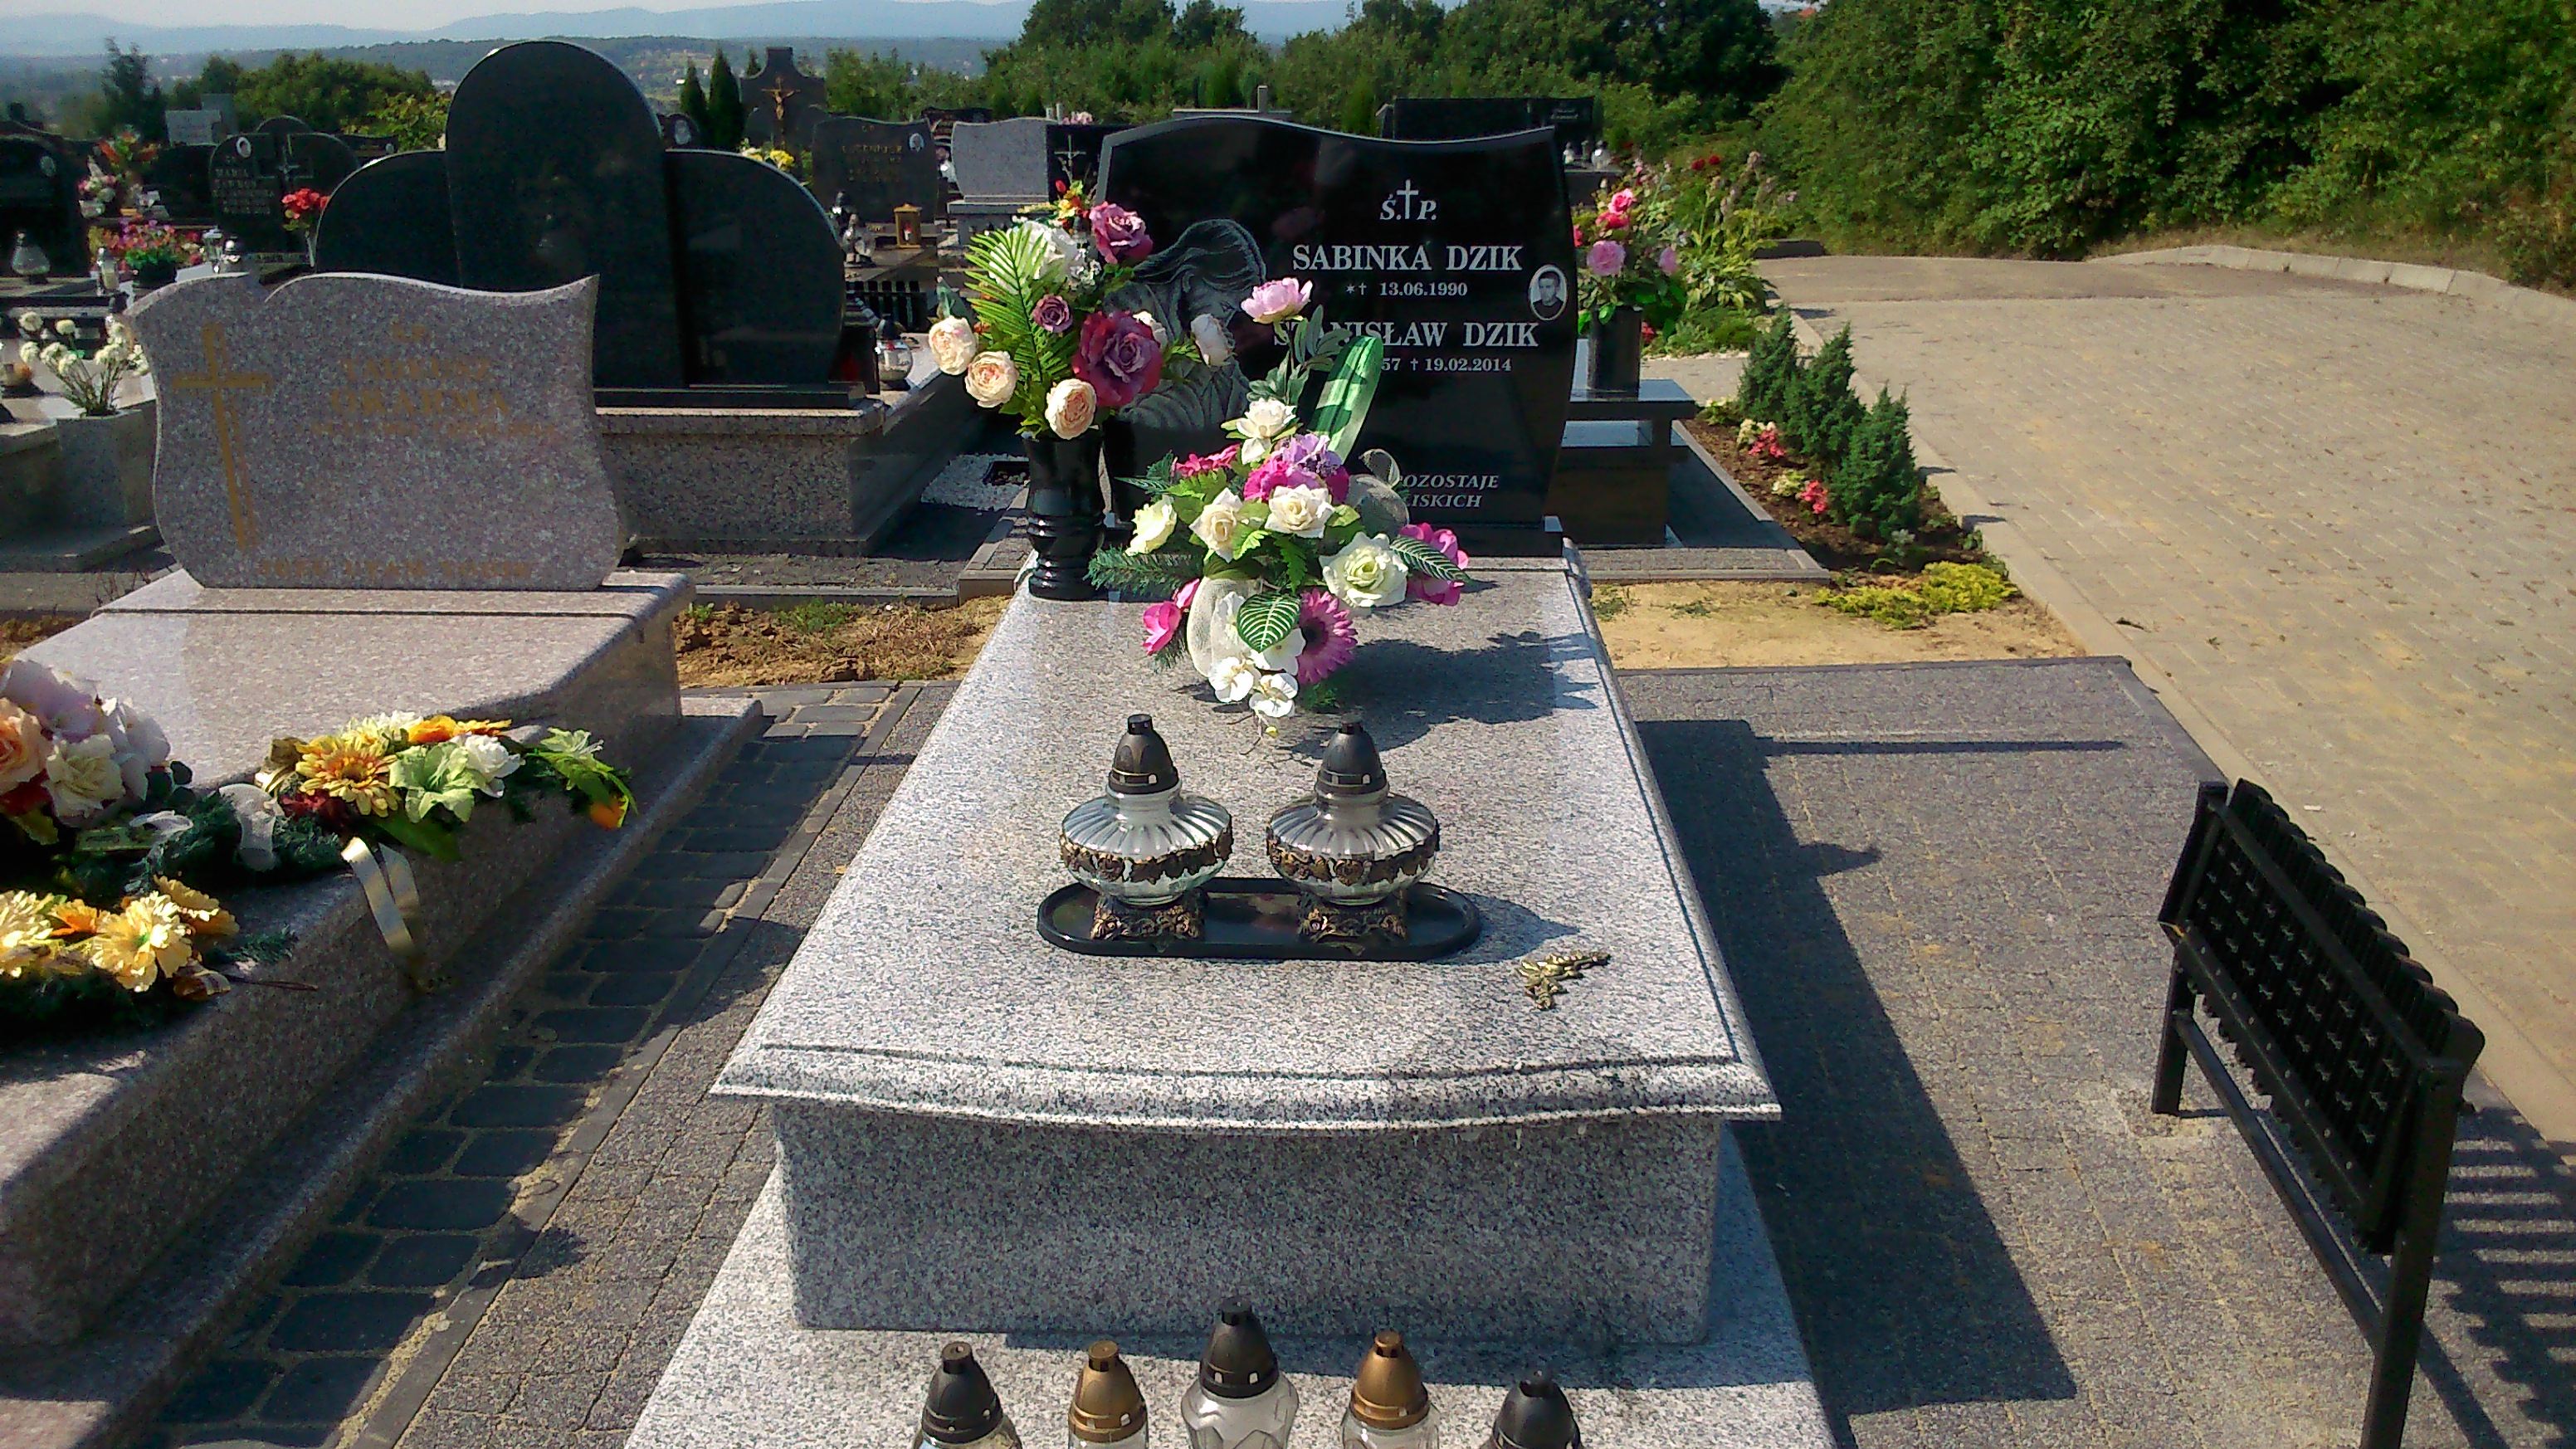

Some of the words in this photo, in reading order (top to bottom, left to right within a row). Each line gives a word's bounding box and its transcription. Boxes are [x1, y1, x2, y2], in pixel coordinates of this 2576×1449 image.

[1379, 193, 1402, 221] Ś.
[1417, 200, 1437, 221] P.
[1293, 245, 1432, 271] SABINKA
[1446, 245, 1524, 271] DZIK
[1379, 282, 1468, 296] 13.06.1990
[1273, 322, 1448, 346] SNISŁAW
[1463, 322, 1539, 346] DZIK
[339, 357, 491, 380] TADEUSZ
[1425, 358, 1512, 372] 19.02.2014
[329, 388, 511, 416] OKARMA
[1400, 475, 1500, 490] OZOSTAJE
[1407, 495, 1482, 508] ISKICH
